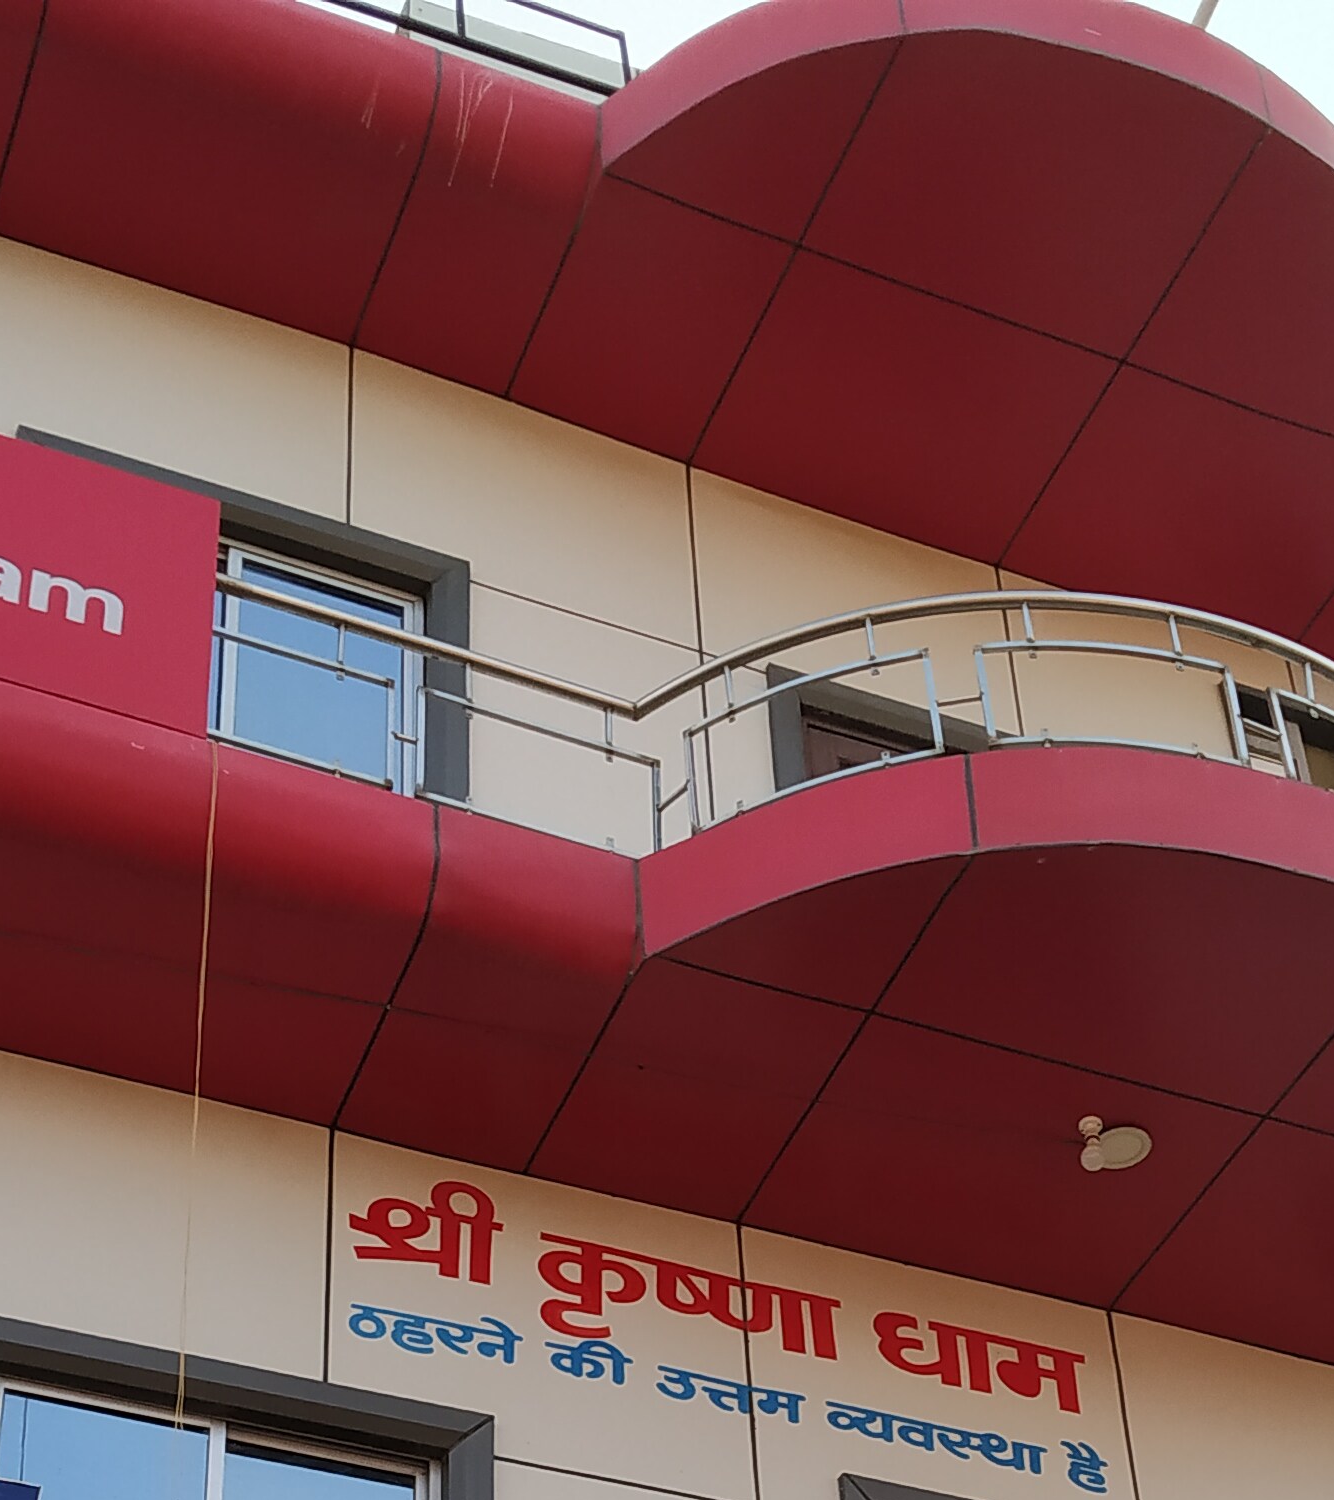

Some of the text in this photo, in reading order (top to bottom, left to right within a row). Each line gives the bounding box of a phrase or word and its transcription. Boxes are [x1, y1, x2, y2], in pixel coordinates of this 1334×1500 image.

[348, 1303, 1109, 1494] ठहरने की उत्तम व्यवस्था है
[349, 1180, 1085, 1415] श्री कृष्णा धाम
